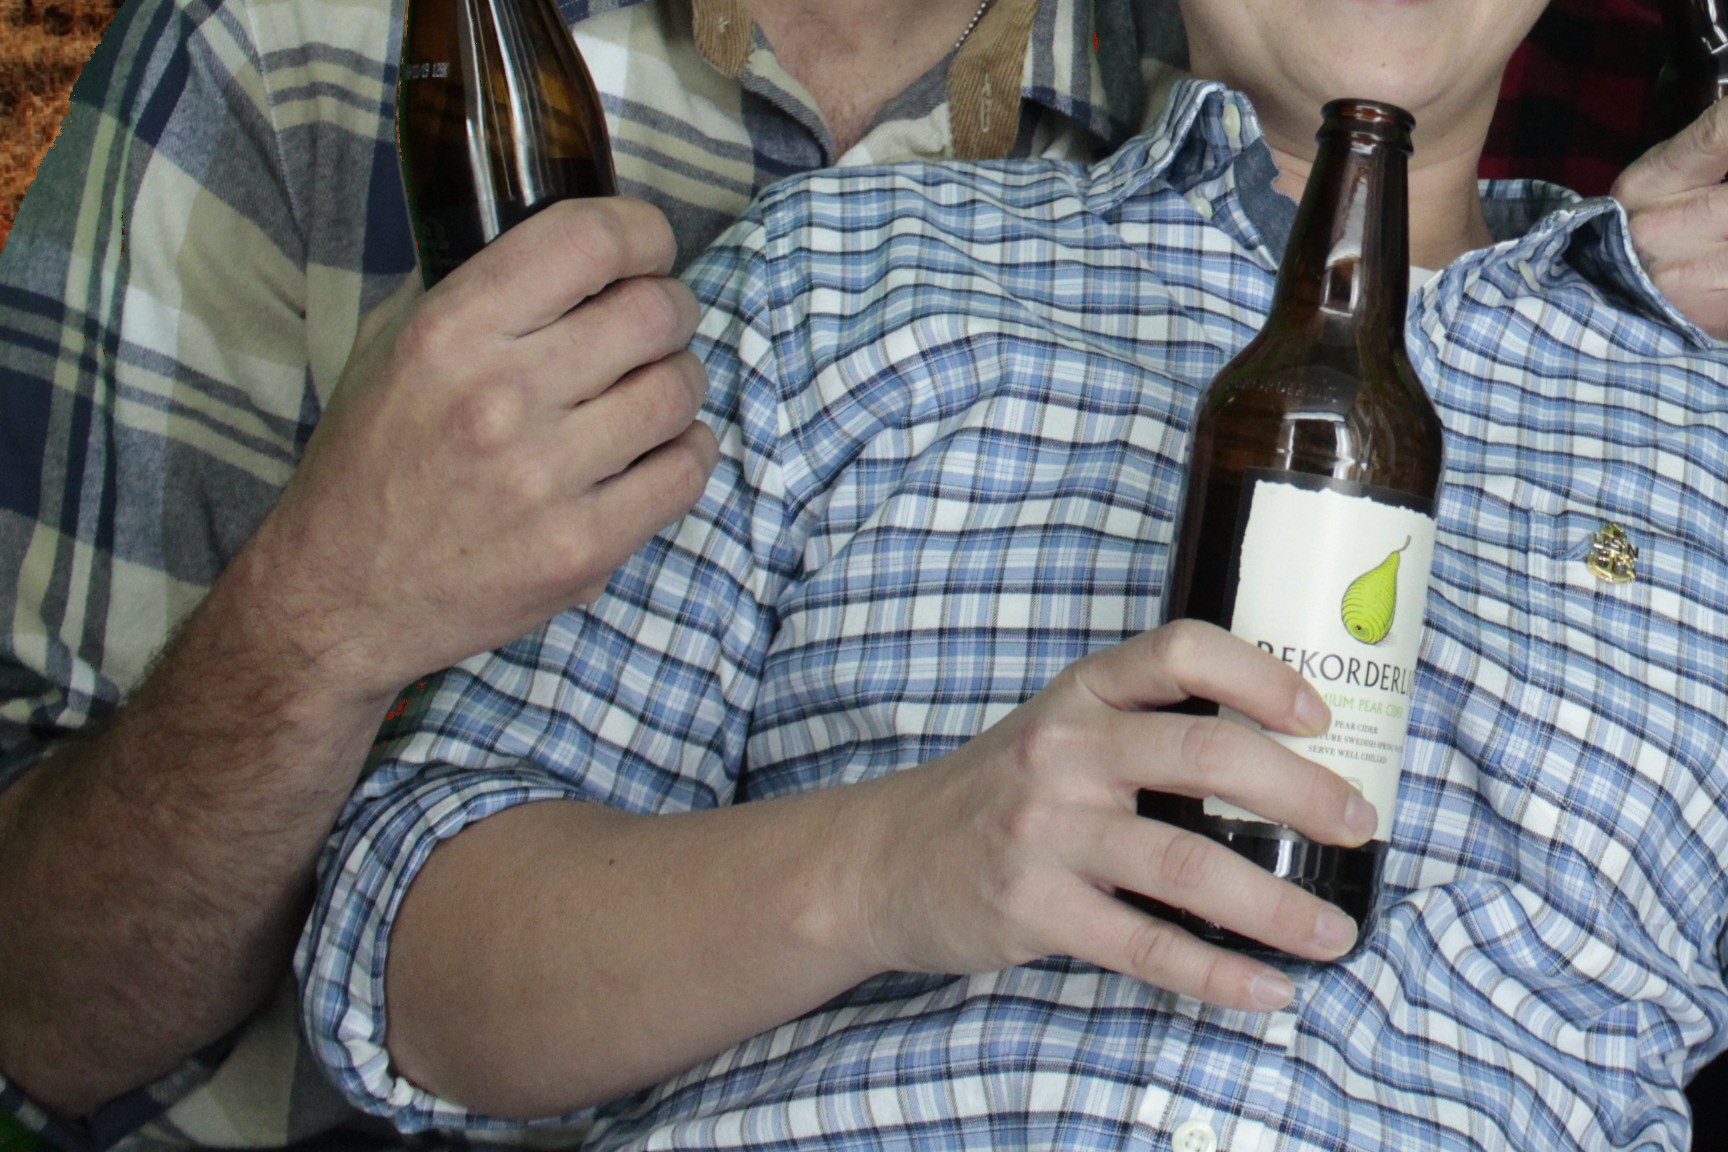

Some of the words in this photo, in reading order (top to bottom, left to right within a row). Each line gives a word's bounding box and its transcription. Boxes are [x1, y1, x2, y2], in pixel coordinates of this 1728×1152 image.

[1359, 697, 1383, 715] PEAR
[1334, 719, 1356, 731] PEAR
[1356, 723, 1378, 734] CIDER
[1344, 735, 1377, 748] SWEDISH
[1307, 744, 1336, 756] SERVE
[1338, 748, 1360, 761] WELL
[1360, 752, 1388, 765] CHILLED
